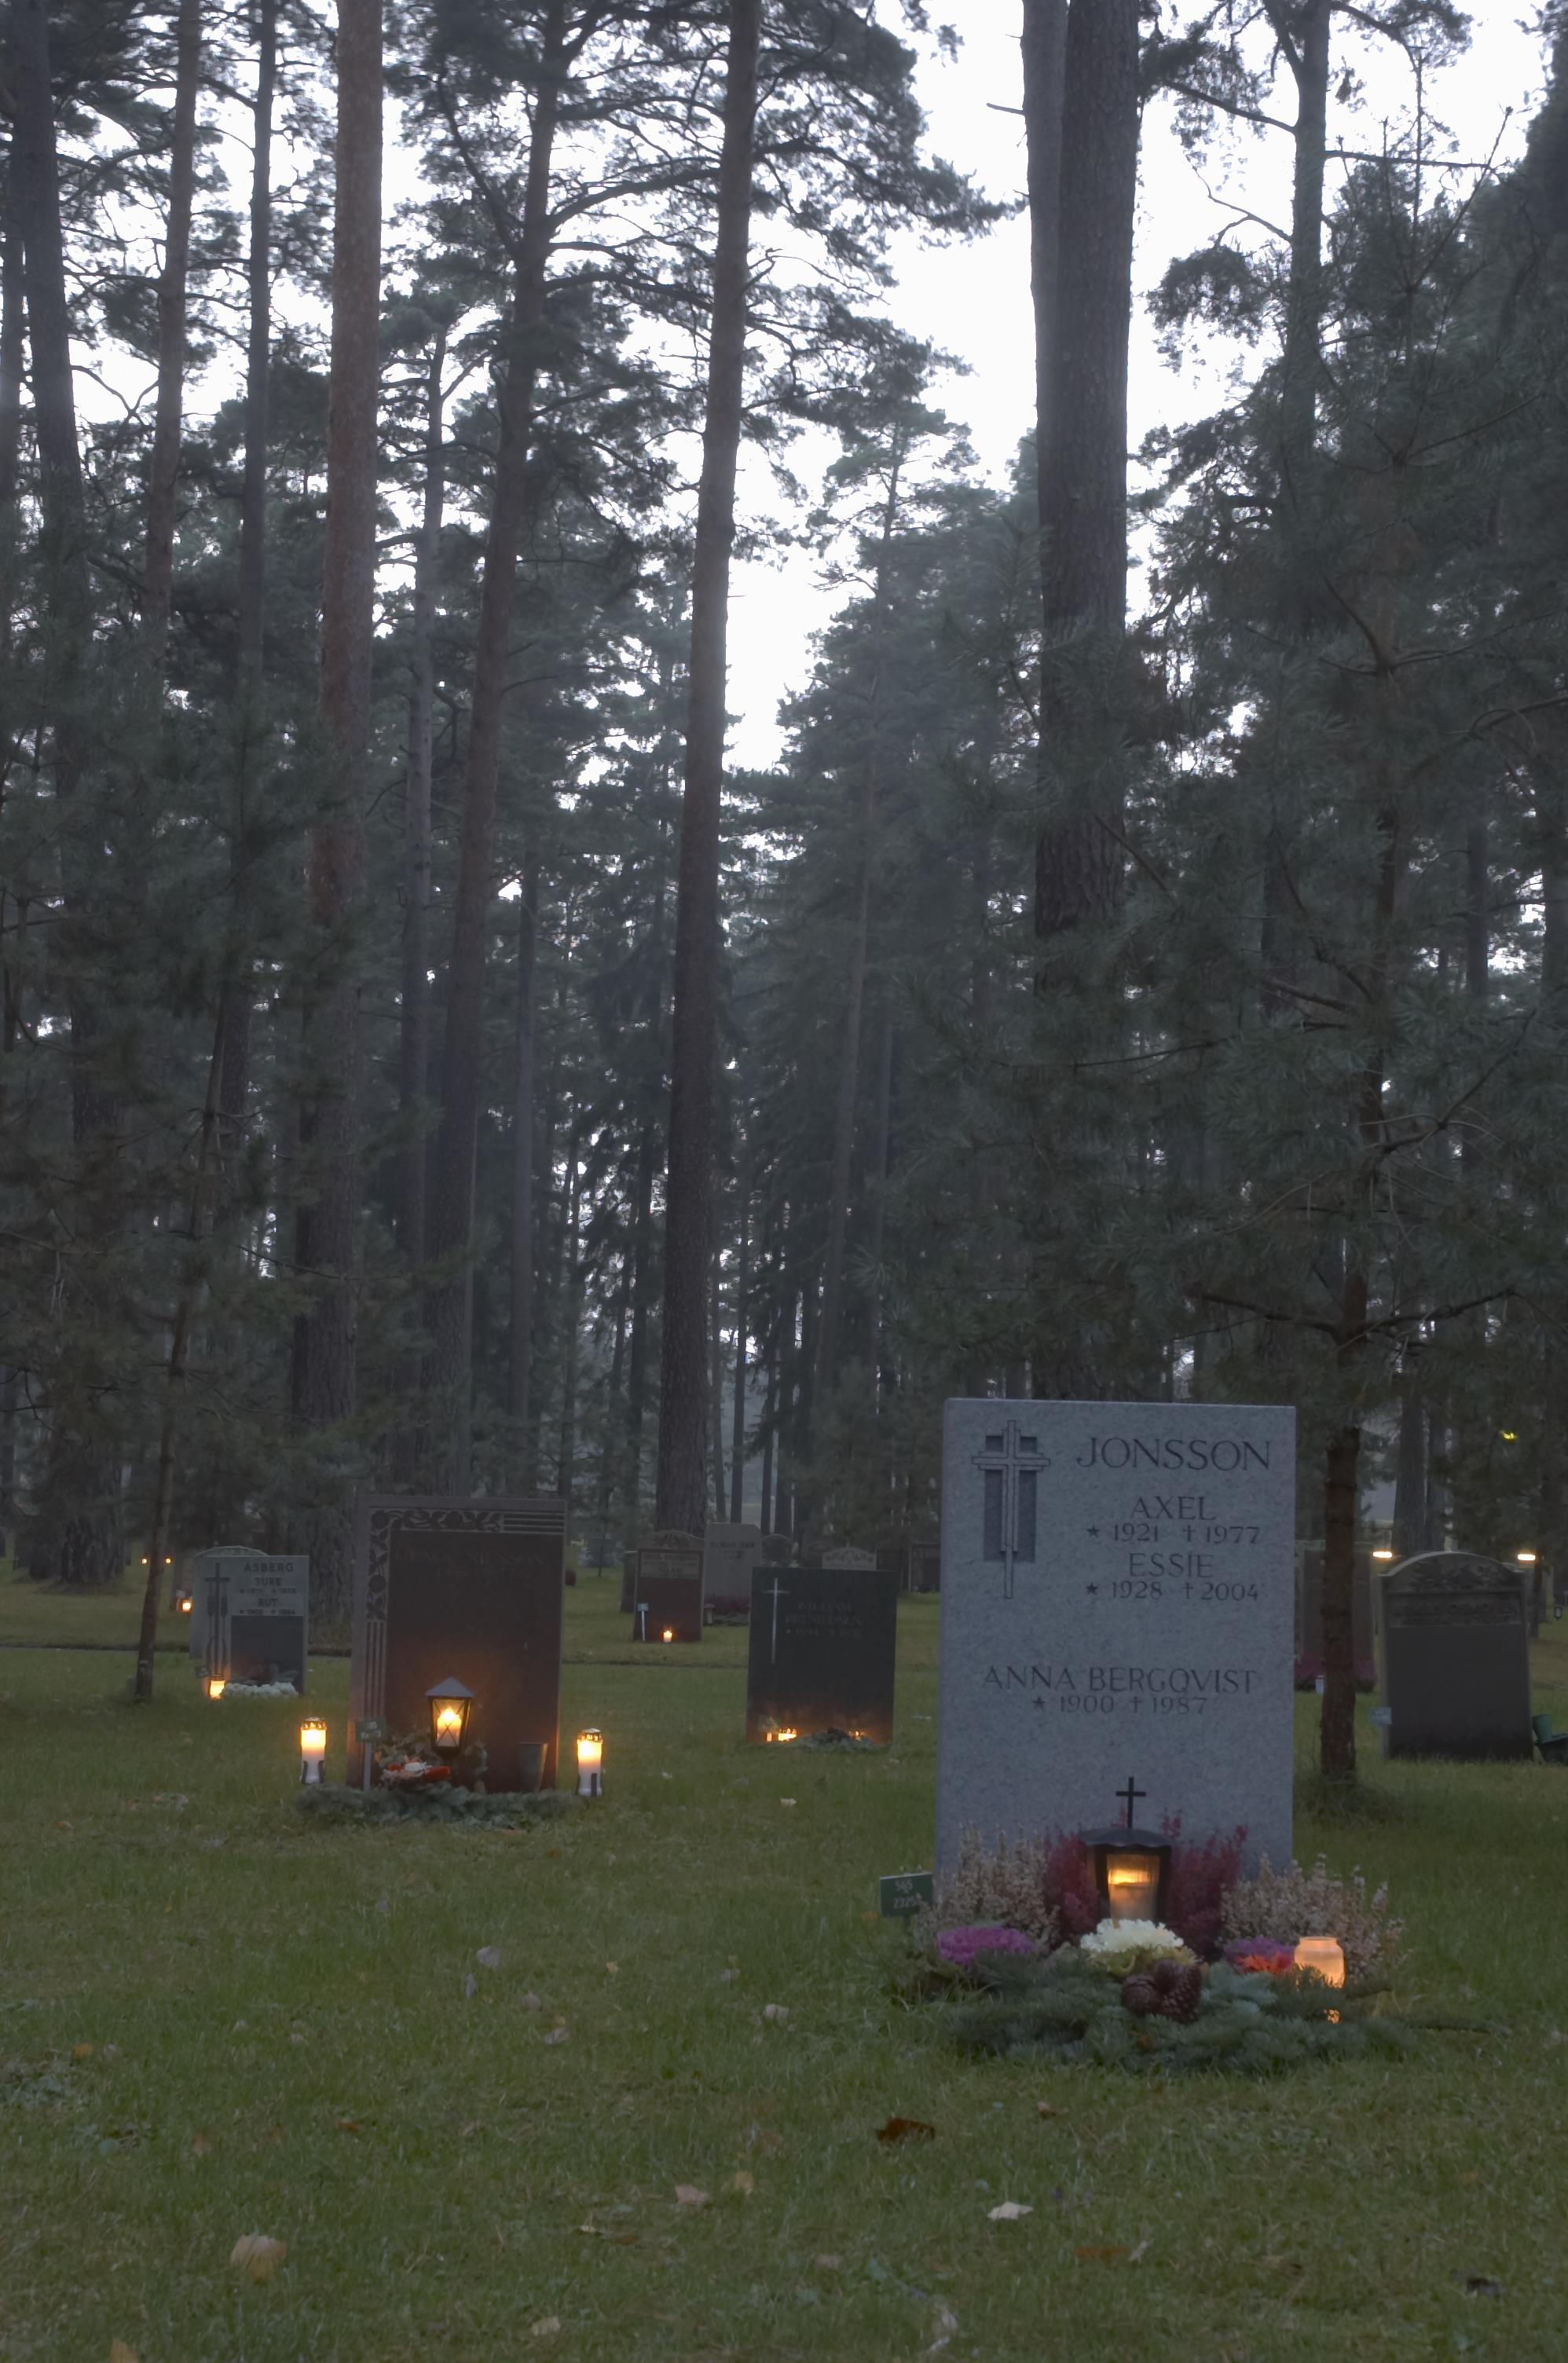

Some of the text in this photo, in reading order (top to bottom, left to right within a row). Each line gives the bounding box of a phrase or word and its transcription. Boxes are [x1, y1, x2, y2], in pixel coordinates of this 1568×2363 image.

[1076, 1436, 1270, 1471] JONSSON
[1130, 1496, 1217, 1521] AXEL
[1112, 1522, 1261, 1544] 1921 1977
[1129, 1551, 1214, 1579] ESSIE
[1112, 1580, 1259, 1602] 1928 2004
[984, 1665, 1257, 1694] ANNA BERGQVIST
[1060, 1694, 1115, 1714] 1900
